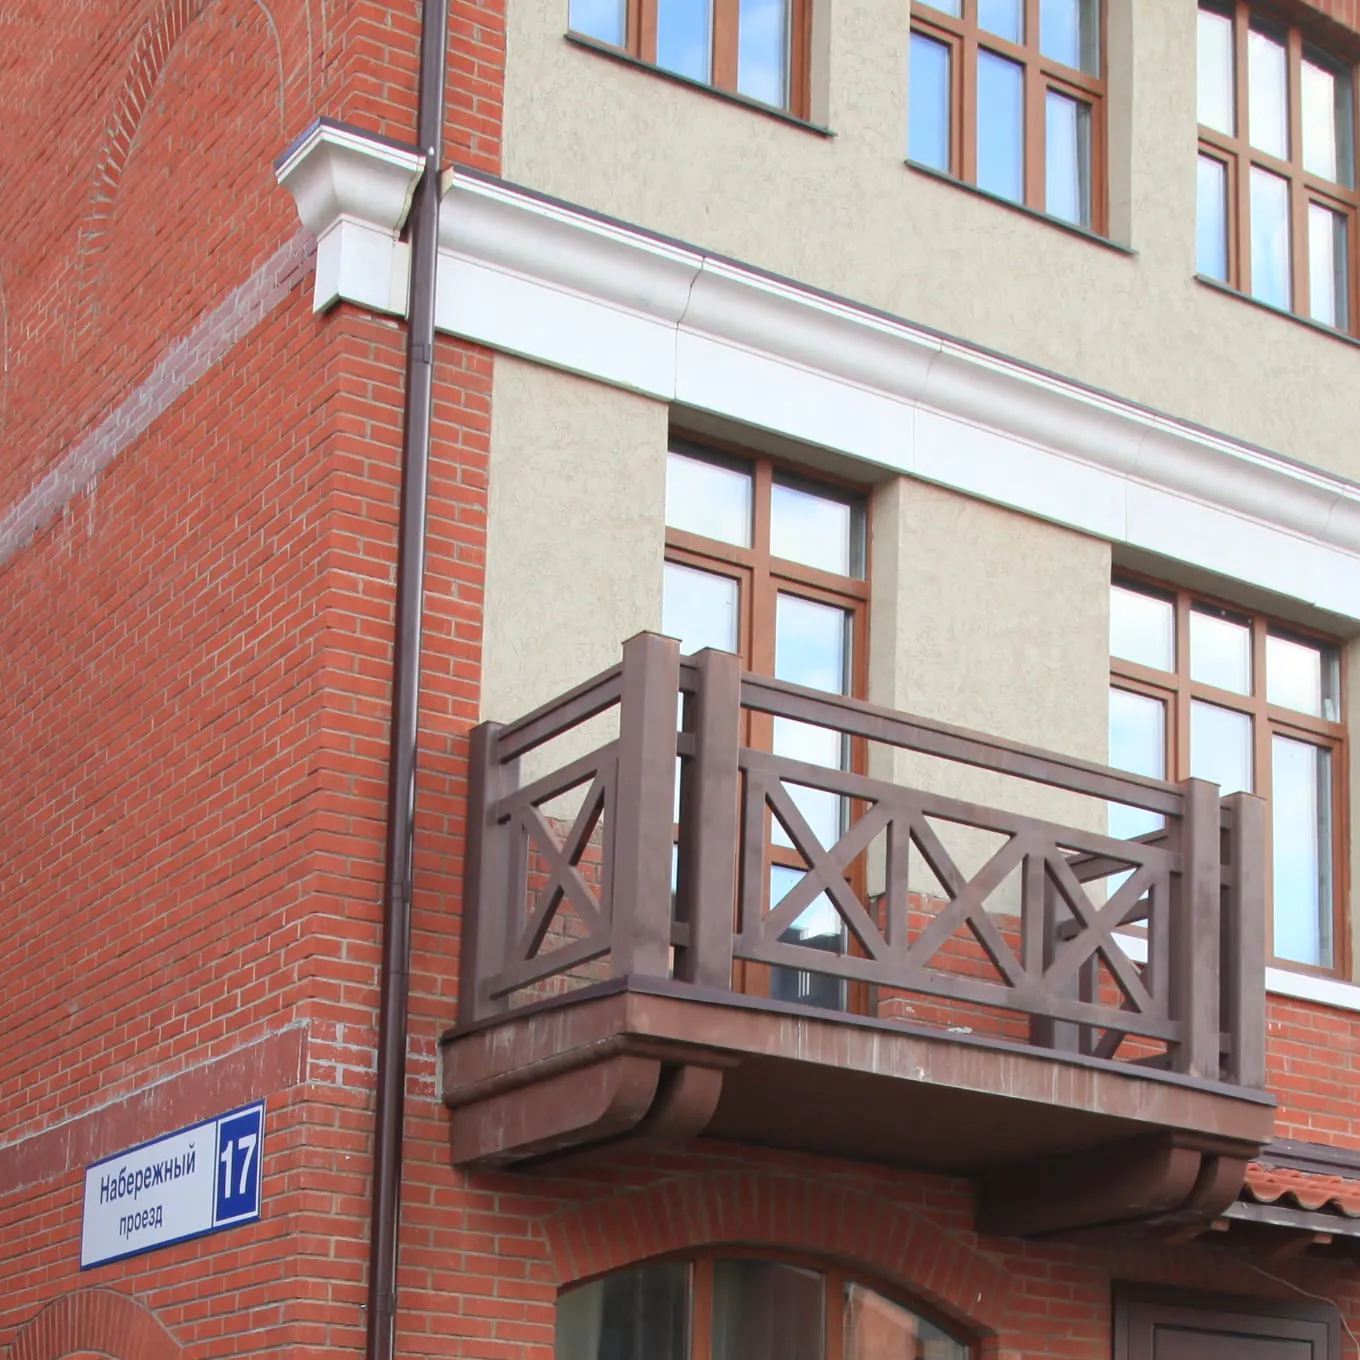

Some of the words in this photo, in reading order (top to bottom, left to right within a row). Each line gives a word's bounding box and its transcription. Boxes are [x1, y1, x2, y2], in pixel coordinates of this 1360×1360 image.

[100, 1142, 196, 1204] Набережный
[220, 1133, 257, 1199] 17
[119, 1204, 163, 1240] проезд
